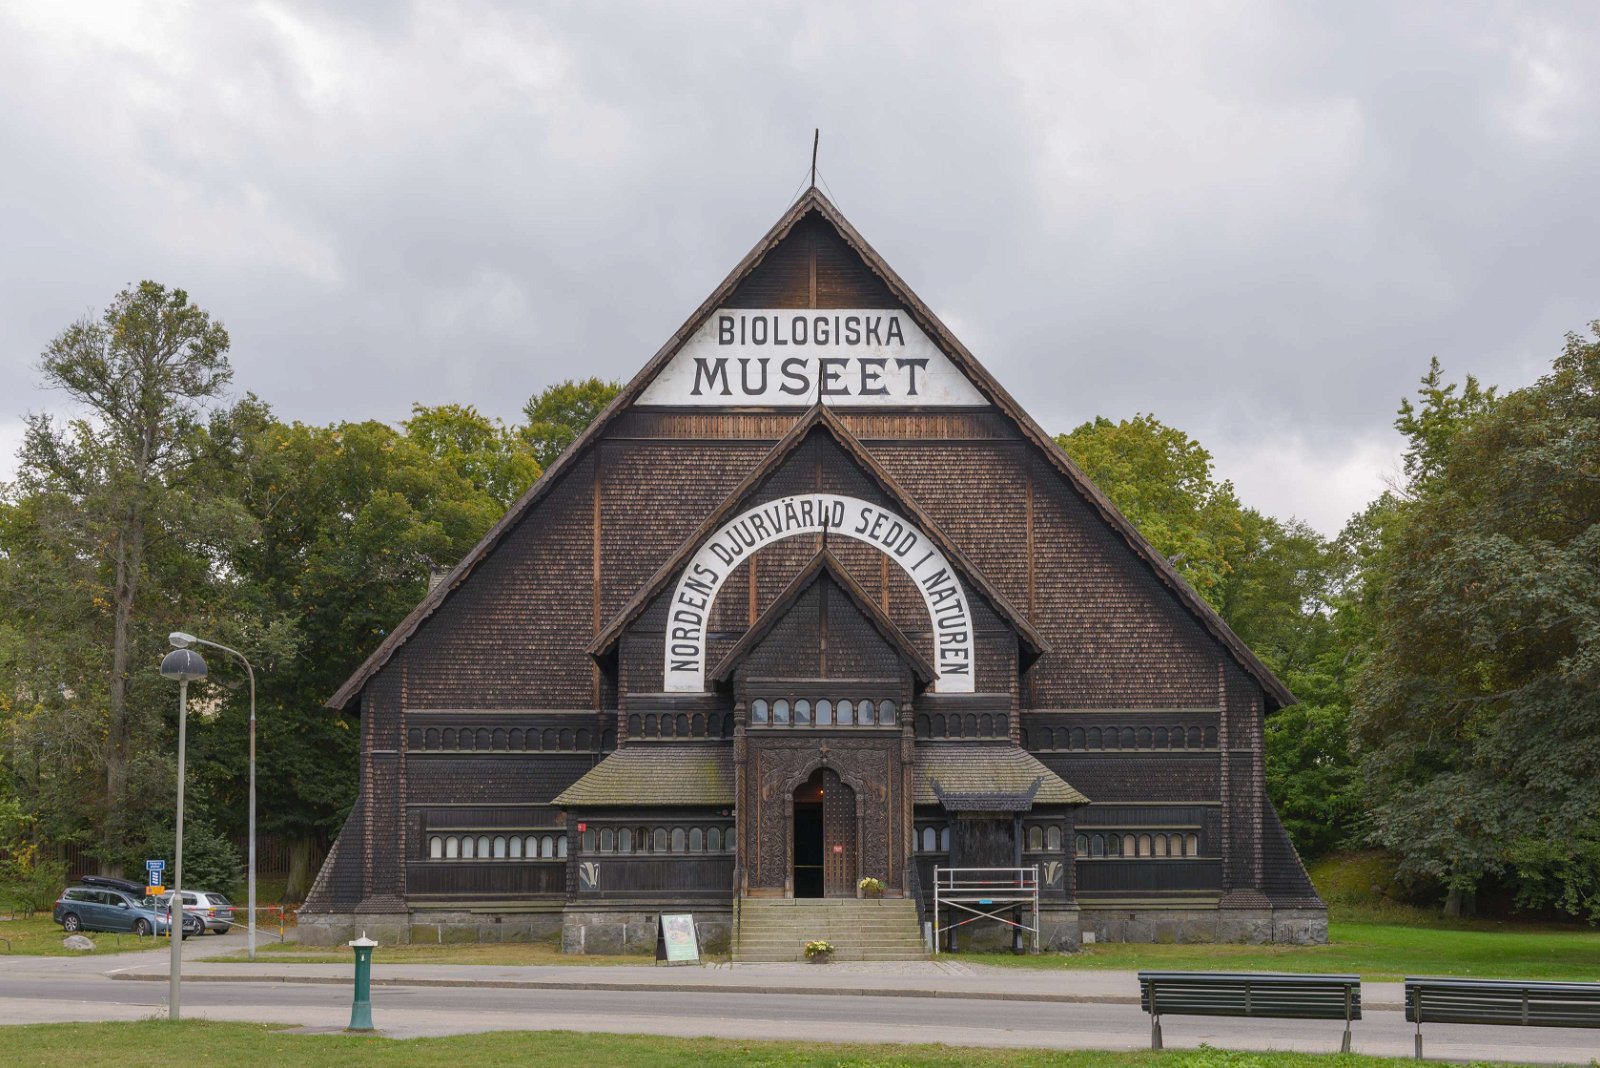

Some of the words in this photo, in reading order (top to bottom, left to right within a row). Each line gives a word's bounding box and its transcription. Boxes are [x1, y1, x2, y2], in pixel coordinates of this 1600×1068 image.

[719, 316, 905, 345] BIOLOGISKA
[690, 358, 929, 395] MUSEET
[670, 563, 719, 672] NORDENS
[709, 498, 845, 566] DJURVÄRLD
[855, 507, 917, 557] SEDD
[910, 550, 933, 571] I
[922, 568, 968, 675] NATUREN
